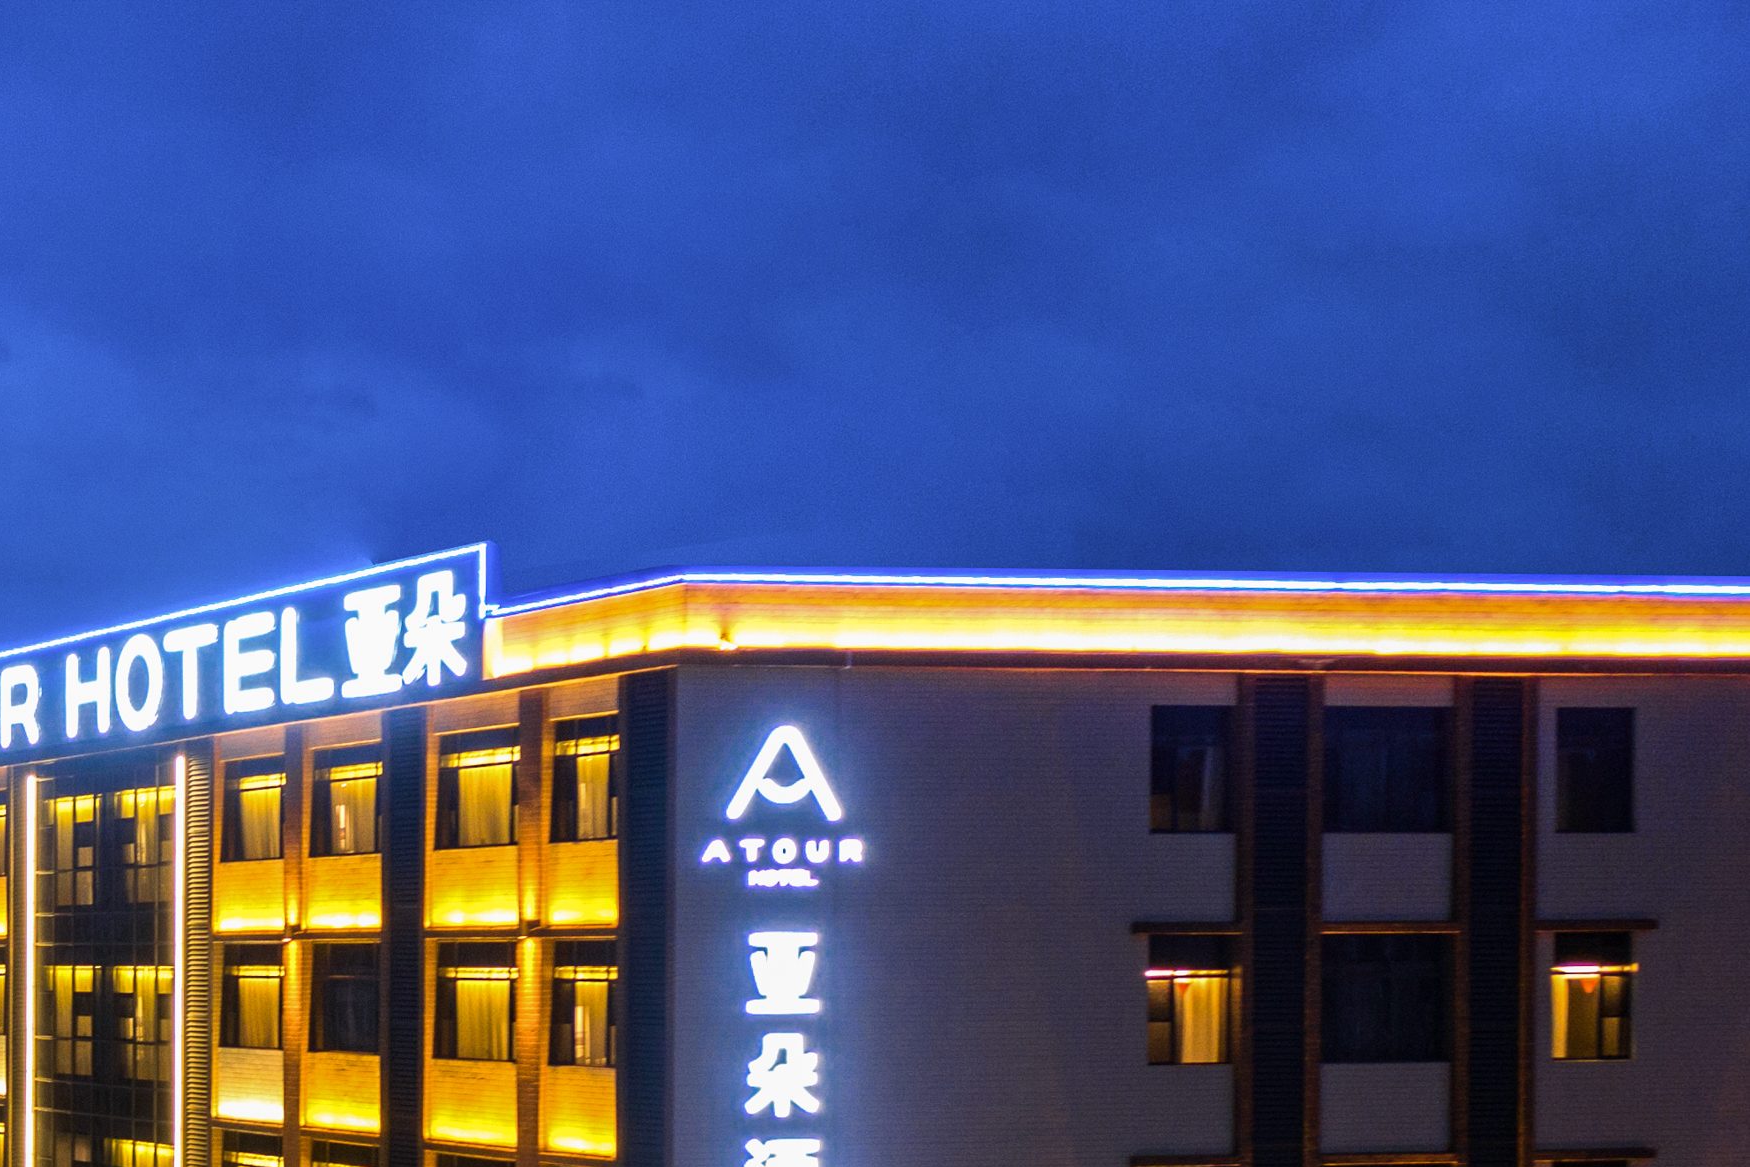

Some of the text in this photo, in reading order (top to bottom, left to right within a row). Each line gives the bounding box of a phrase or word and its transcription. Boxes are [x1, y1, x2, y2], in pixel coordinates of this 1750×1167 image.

[65, 607, 335, 739] HOTEL
[341, 569, 467, 699] 亚朵
[701, 837, 865, 864] ATOUR
[747, 869, 819, 887] HOTEL
